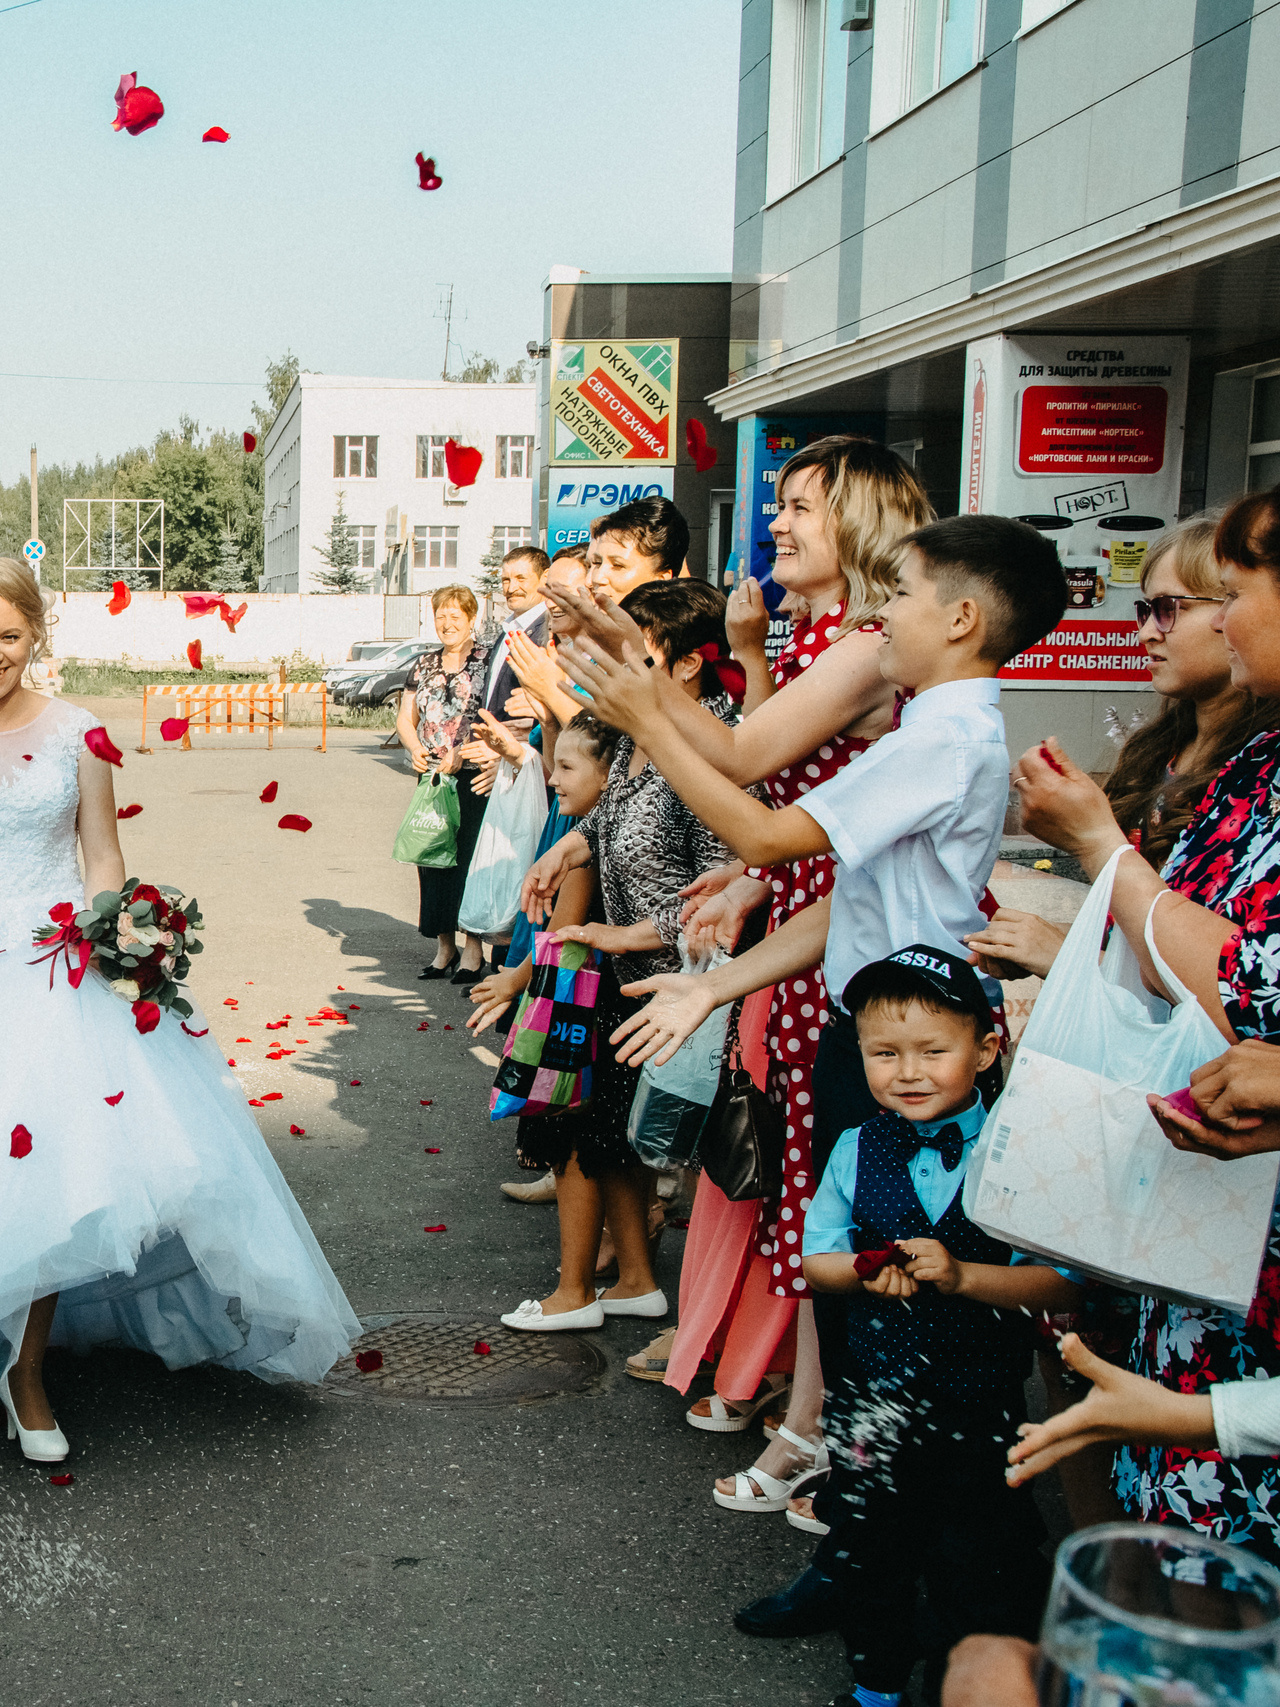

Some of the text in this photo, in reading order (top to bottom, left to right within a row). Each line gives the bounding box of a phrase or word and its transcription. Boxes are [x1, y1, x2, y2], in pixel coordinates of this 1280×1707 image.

[1067, 350, 1124, 363] СРЕДСТВА
[1019, 366, 1172, 378] ДЛЯ ЗАЩИТЫ ДРЕВЕСИНЫ
[600, 345, 669, 415] ОКНА ПВХ
[1046, 402, 1088, 410] ПРОПИТКИ
[561, 387, 628, 454] НАТЯЖНЫЕ
[586, 376, 665, 457] СВЕТОТЕХНИКА
[555, 401, 613, 459] ПОТОЛКИ
[1041, 428, 1096, 436] АНТИСЕПТИКИ
[555, 530, 591, 543] СЕР
[1033, 631, 1140, 647] ИОНАЛЬНЫЙ
[1059, 655, 1152, 670] СНАБЖЕНИЯ
